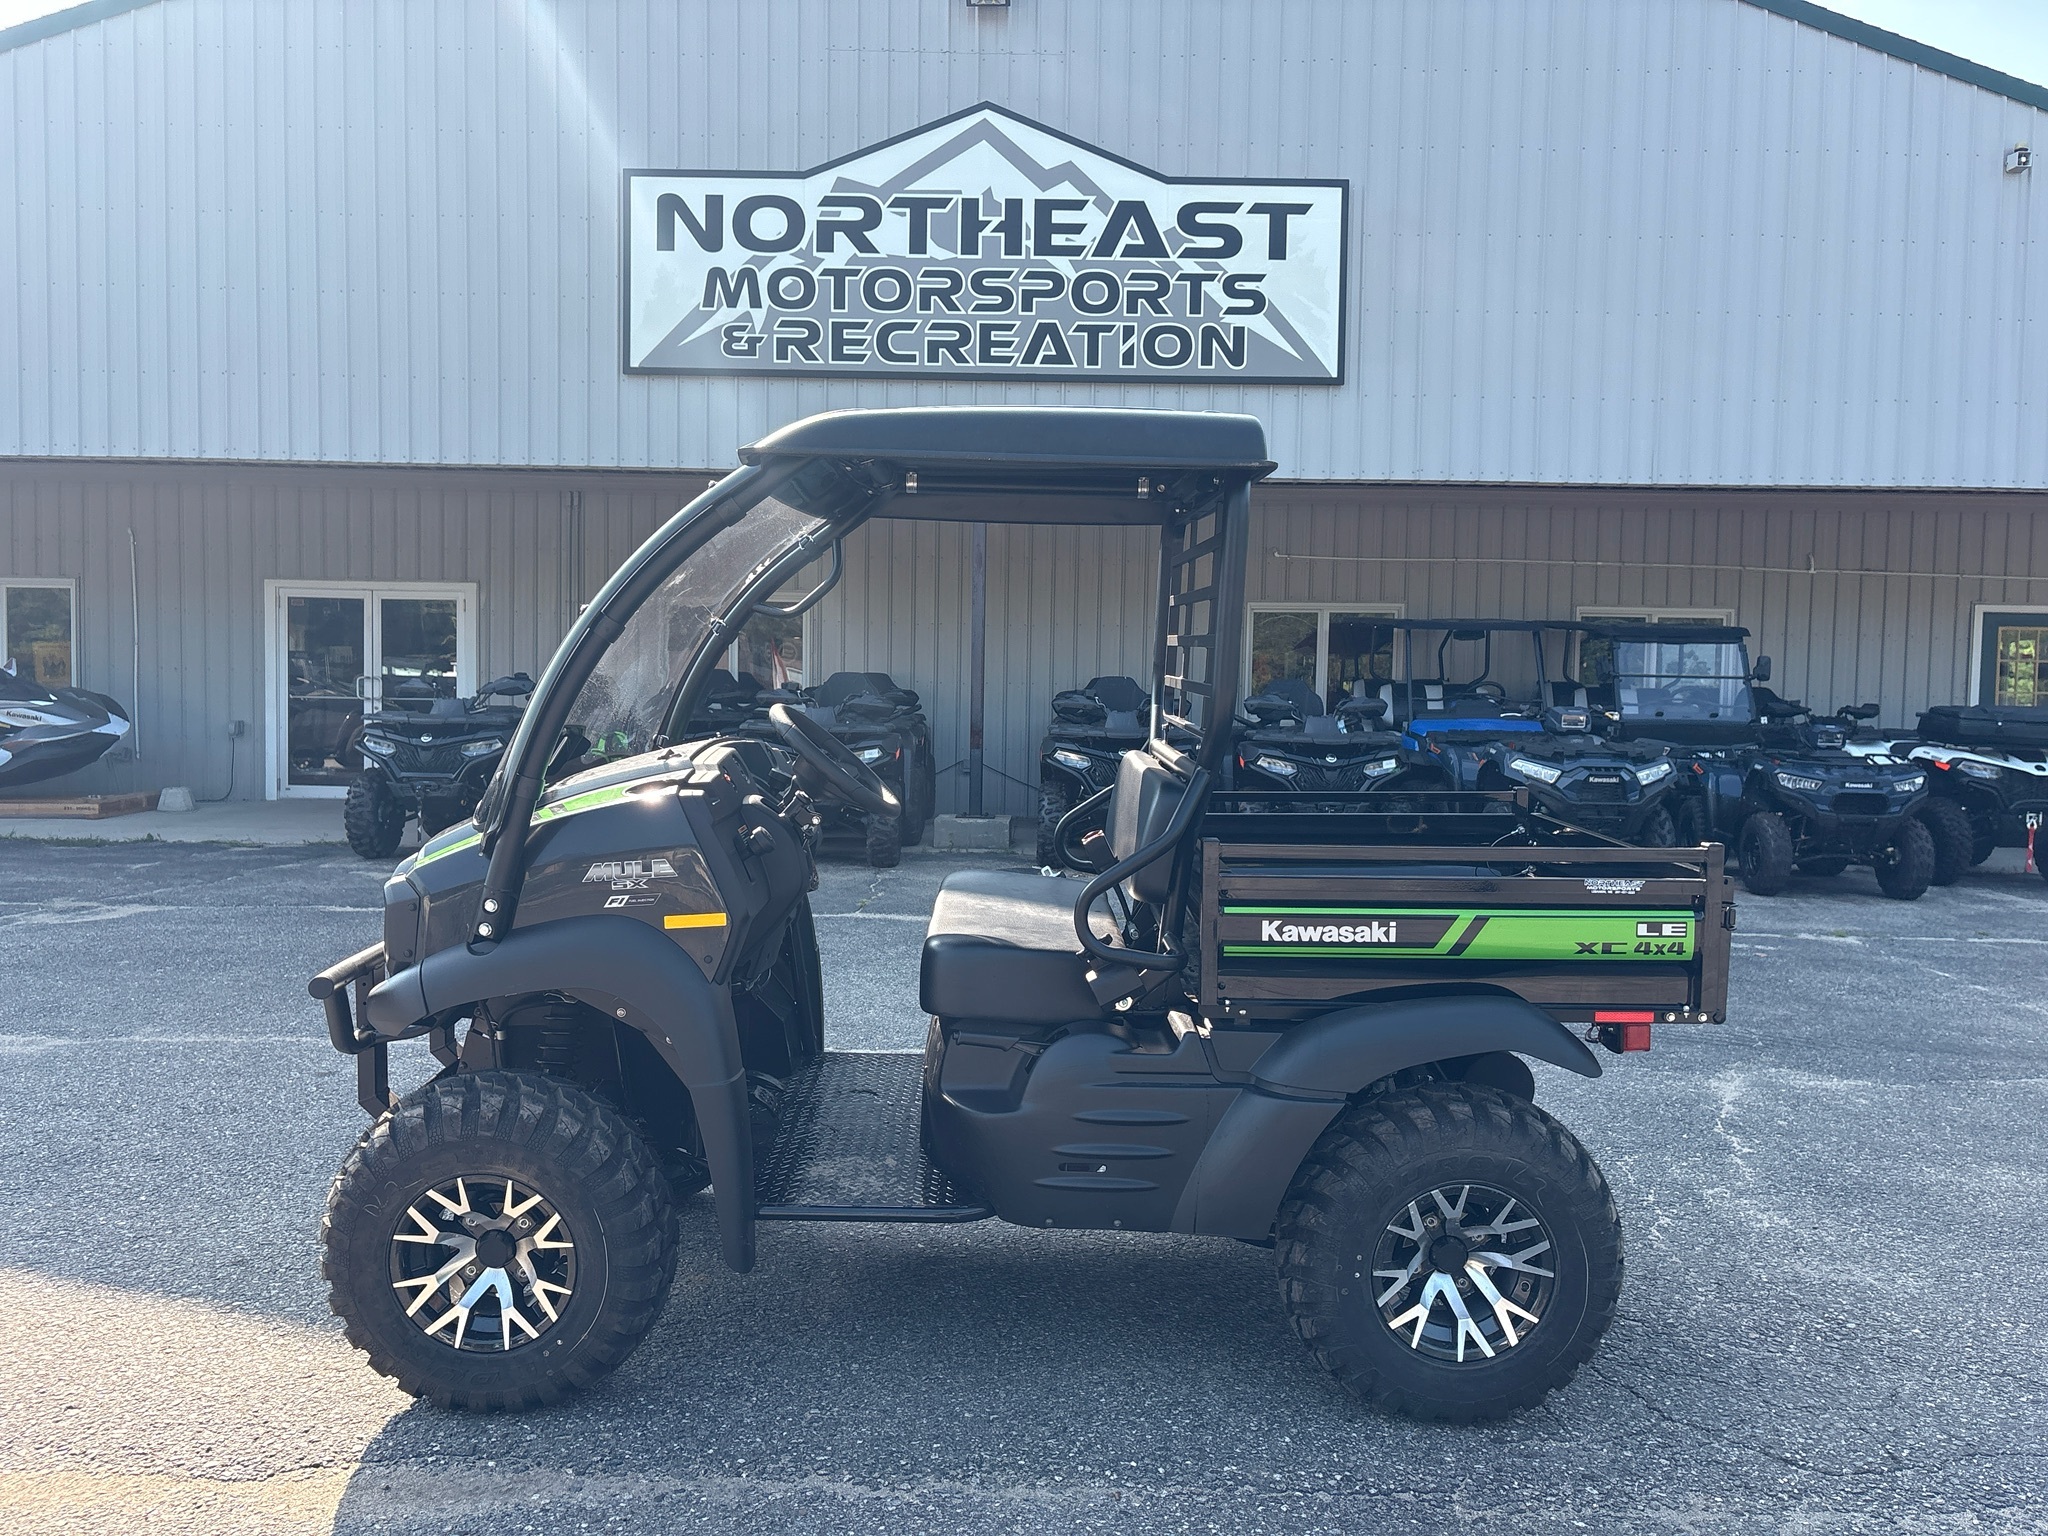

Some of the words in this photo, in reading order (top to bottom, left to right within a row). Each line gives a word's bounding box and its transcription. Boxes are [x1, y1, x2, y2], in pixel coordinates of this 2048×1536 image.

[655, 192, 1314, 262] NORTHEAST
[702, 266, 1268, 316] MOTORSPORTS
[774, 319, 1247, 369] RECREATION
[6, 710, 42, 721] Kawasaki
[582, 859, 678, 882] MULE
[611, 879, 649, 890] SX
[1261, 920, 1397, 943] Kawasaki
[1637, 923, 1687, 936] LE
[1573, 942, 1628, 954] XC
[1633, 941, 1687, 955] 4x4
